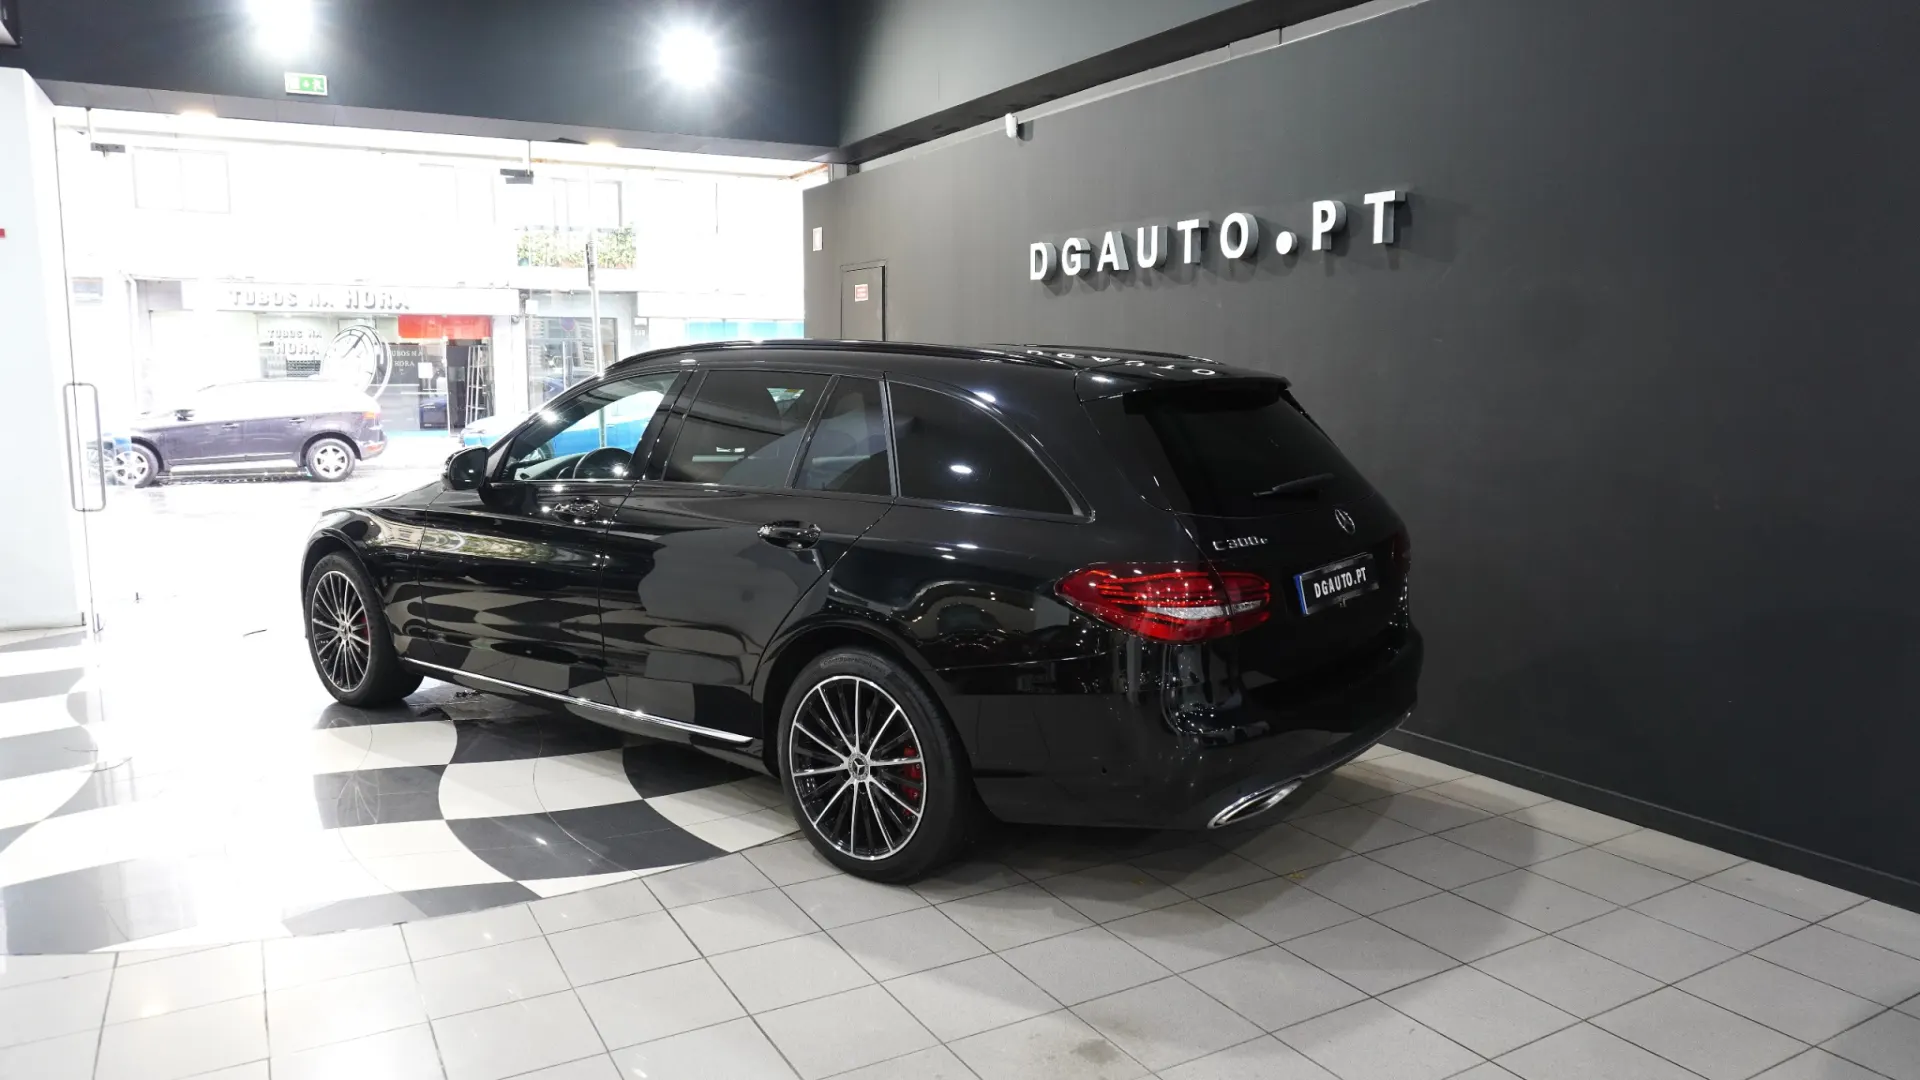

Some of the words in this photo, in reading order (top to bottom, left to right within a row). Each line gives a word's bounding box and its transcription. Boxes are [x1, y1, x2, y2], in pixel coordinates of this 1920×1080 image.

[1029, 190, 1405, 281] DGAUTO.PT
[228, 290, 298, 308] TUBOS
[306, 291, 335, 309] NA
[344, 289, 411, 311] HORA
[1313, 567, 1367, 599] DGAUTO.PT
